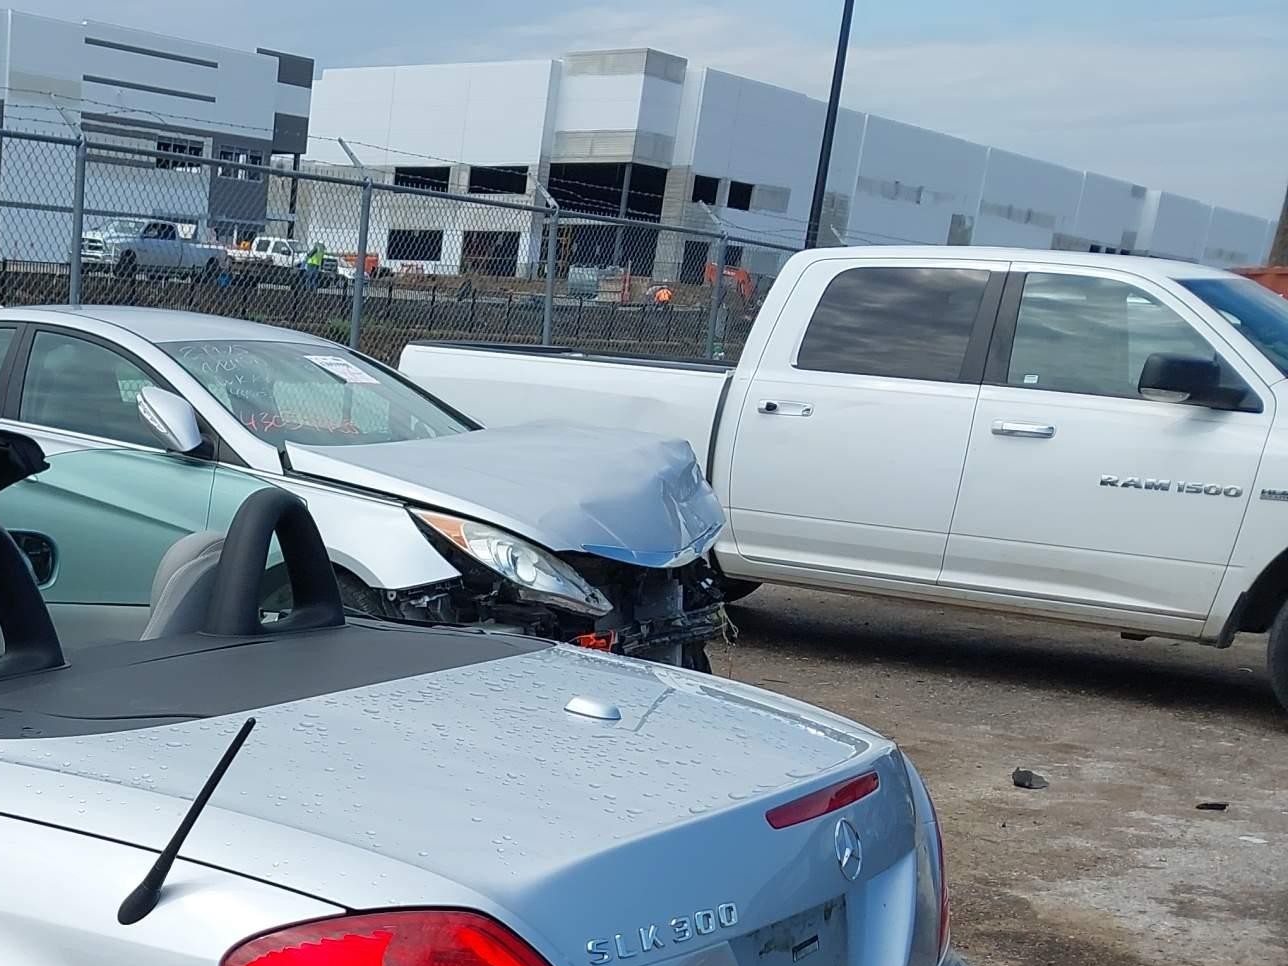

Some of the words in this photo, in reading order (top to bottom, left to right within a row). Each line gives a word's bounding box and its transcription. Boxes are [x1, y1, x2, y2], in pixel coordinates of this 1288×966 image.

[1099, 474, 1171, 492] RAM
[1176, 480, 1243, 498] 1500
[586, 923, 666, 966] SLK
[670, 902, 740, 944] 300
